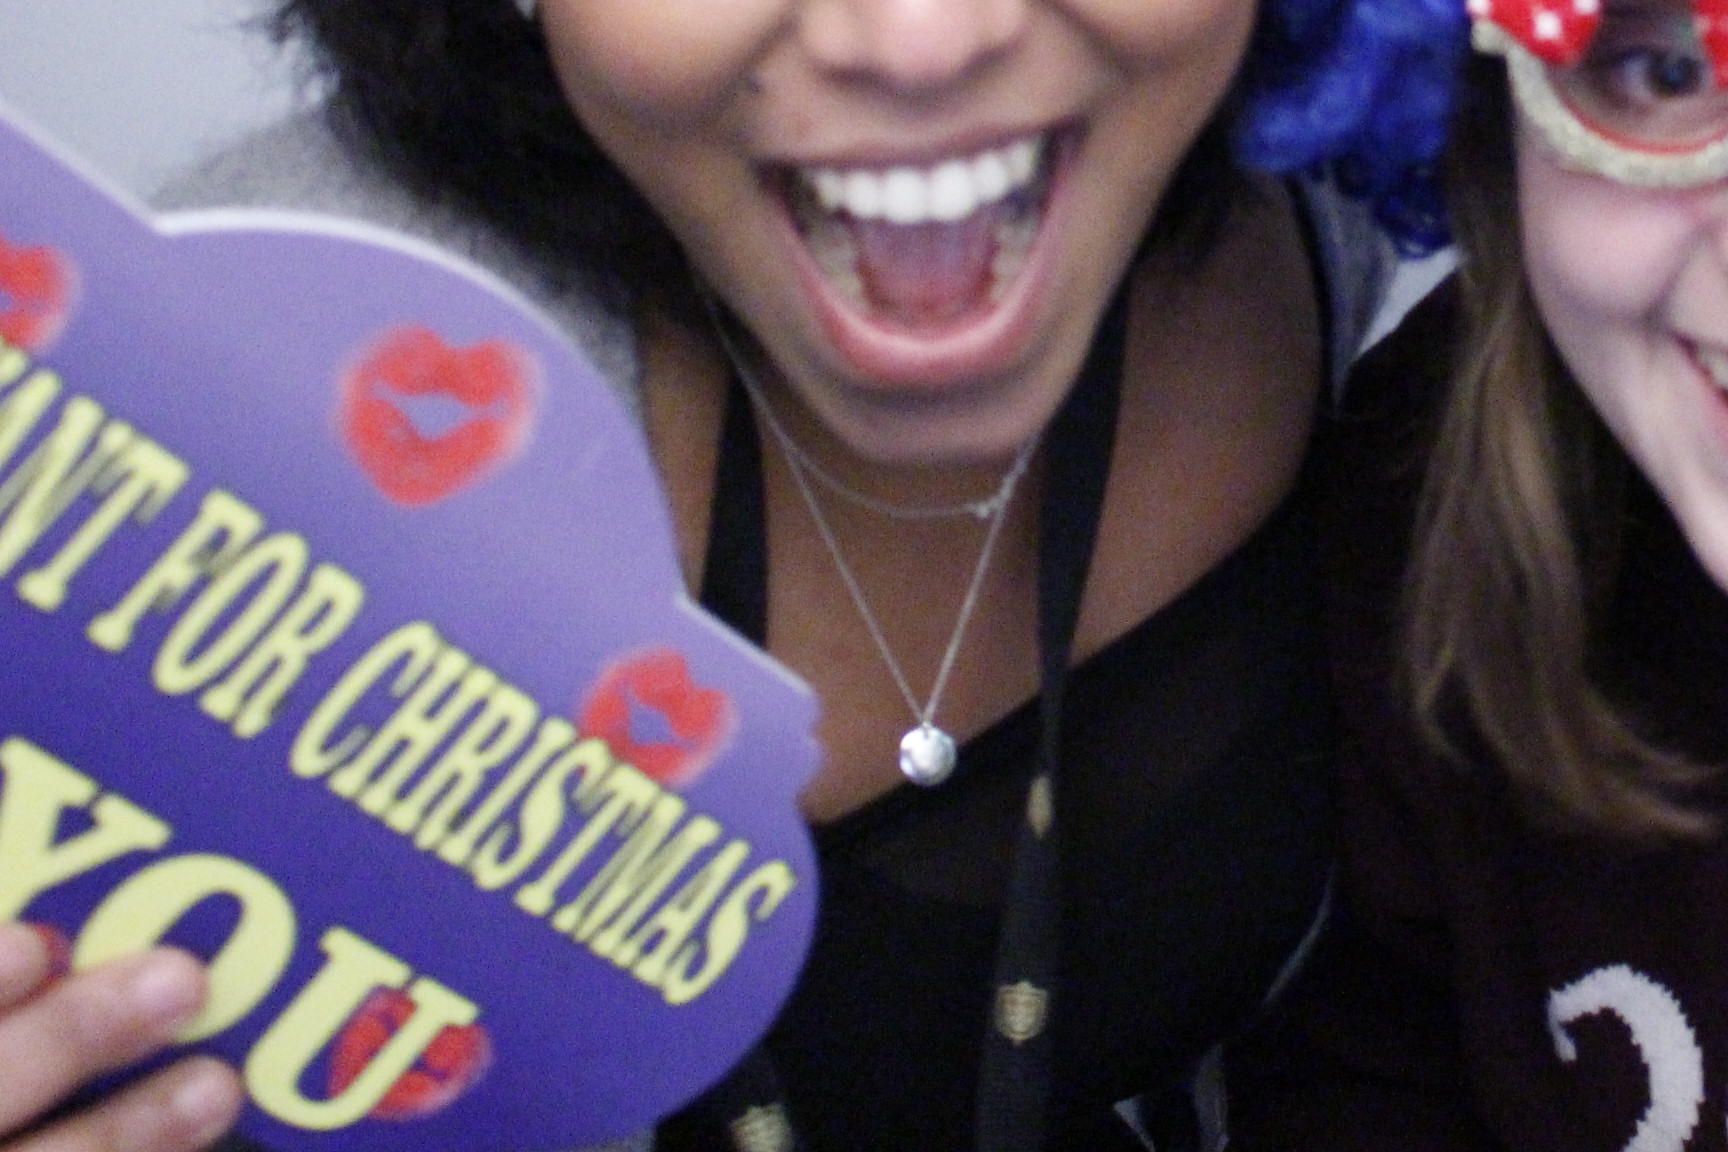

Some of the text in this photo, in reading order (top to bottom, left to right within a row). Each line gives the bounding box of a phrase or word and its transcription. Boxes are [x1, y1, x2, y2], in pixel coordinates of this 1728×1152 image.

[0, 737, 480, 1131] YOU
[86, 490, 366, 737] FOR
[290, 622, 797, 1005] CHRISTMAS
